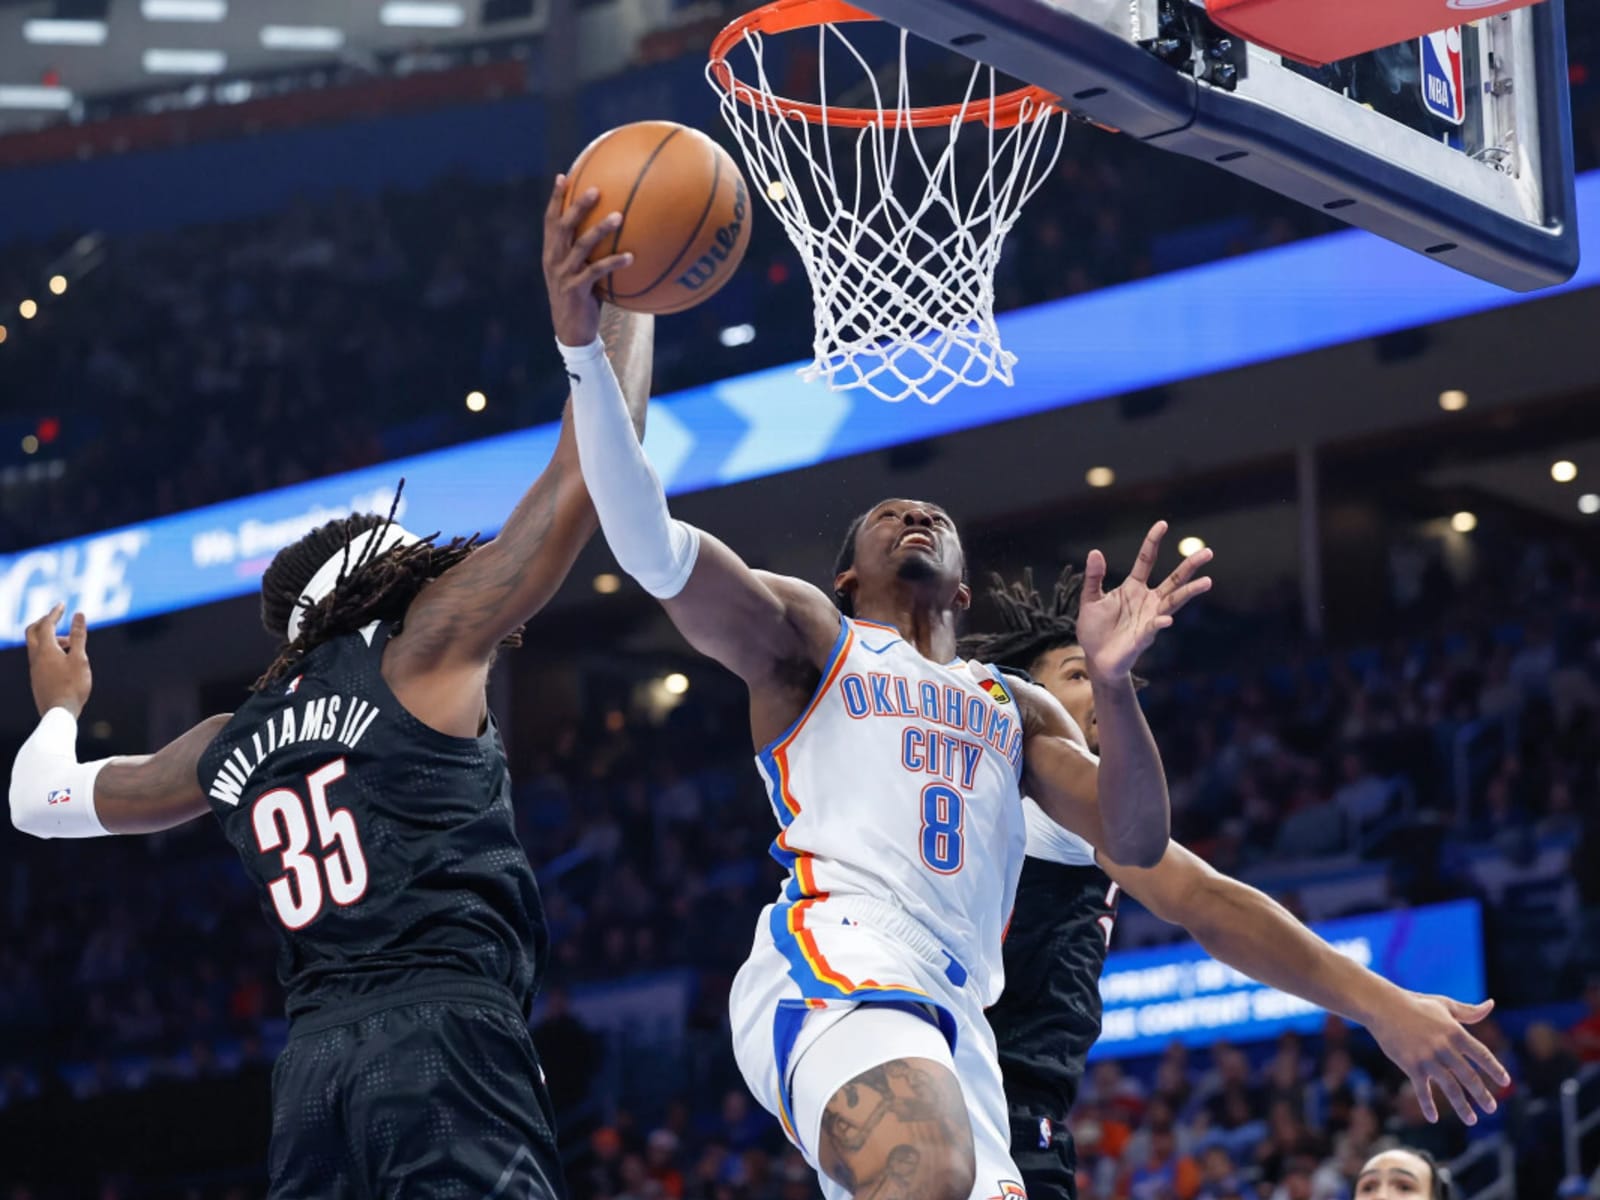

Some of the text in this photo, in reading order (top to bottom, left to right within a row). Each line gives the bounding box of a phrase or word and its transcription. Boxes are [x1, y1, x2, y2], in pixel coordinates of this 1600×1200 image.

[1428, 73, 1449, 109] NBA
[674, 178, 746, 290] Wilson
[208, 694, 380, 807] WILLIAMS III
[840, 672, 1023, 766] OKLAHOMA
[901, 726, 983, 790] CITY
[252, 756, 368, 931] 35
[919, 782, 965, 876] 8
